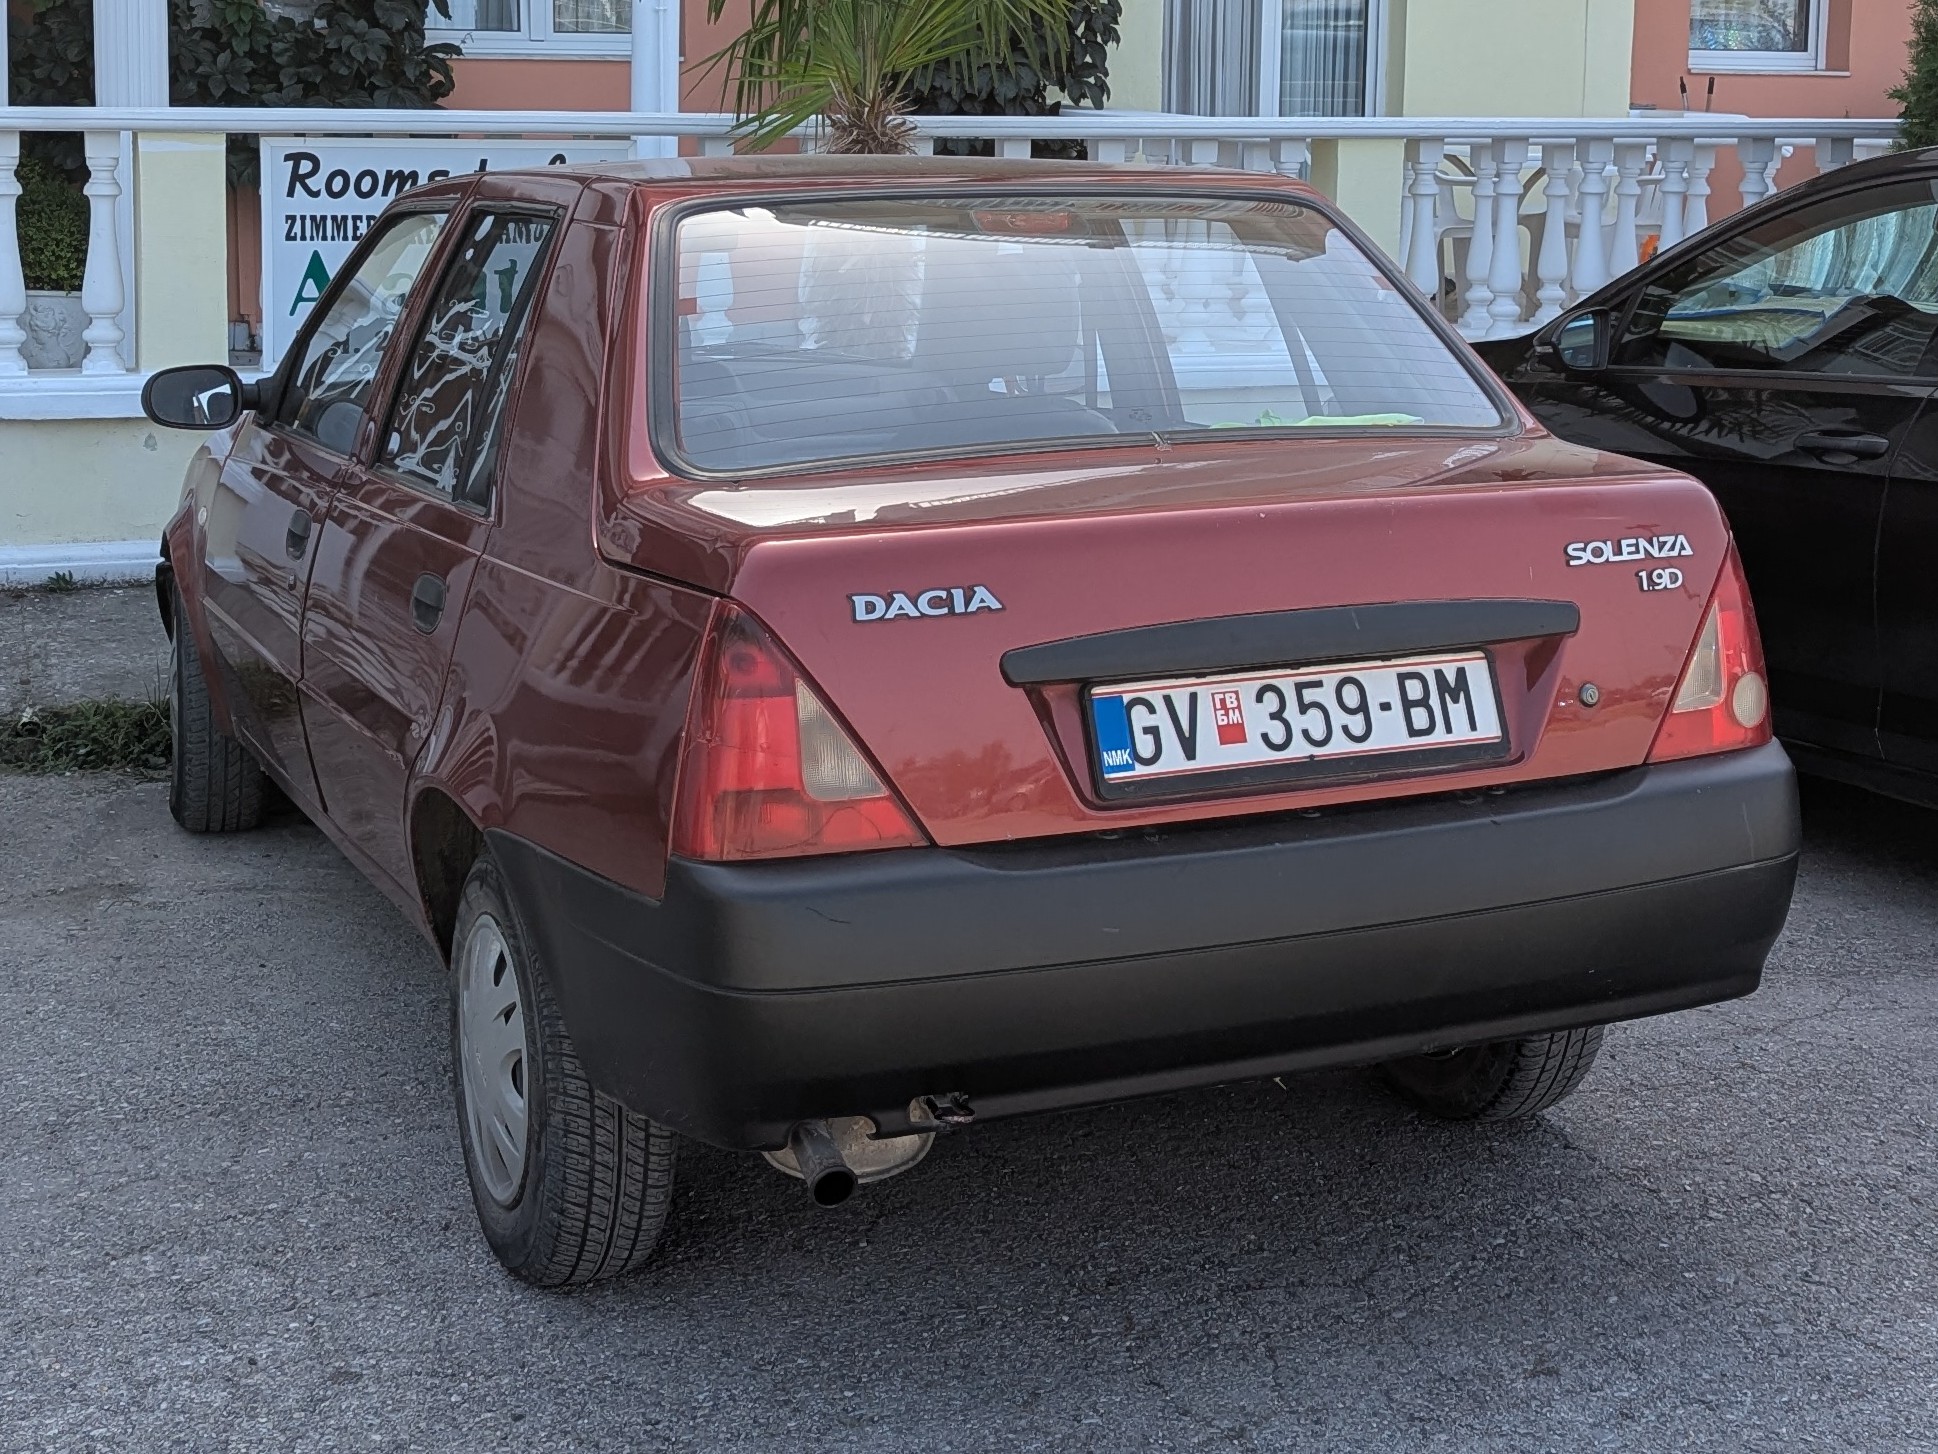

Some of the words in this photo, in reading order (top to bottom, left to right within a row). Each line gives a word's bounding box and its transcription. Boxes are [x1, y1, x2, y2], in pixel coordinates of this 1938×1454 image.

[1566, 535, 1693, 566] SOLENZA
[1638, 567, 1683, 591] 1.9D
[851, 586, 1003, 621] DACIA
[1213, 692, 1239, 709] ГВ
[1124, 692, 1199, 767] GV
[1255, 666, 1478, 752] 359-BM
[1216, 708, 1243, 726] БМ
[1102, 748, 1133, 767] NMK
